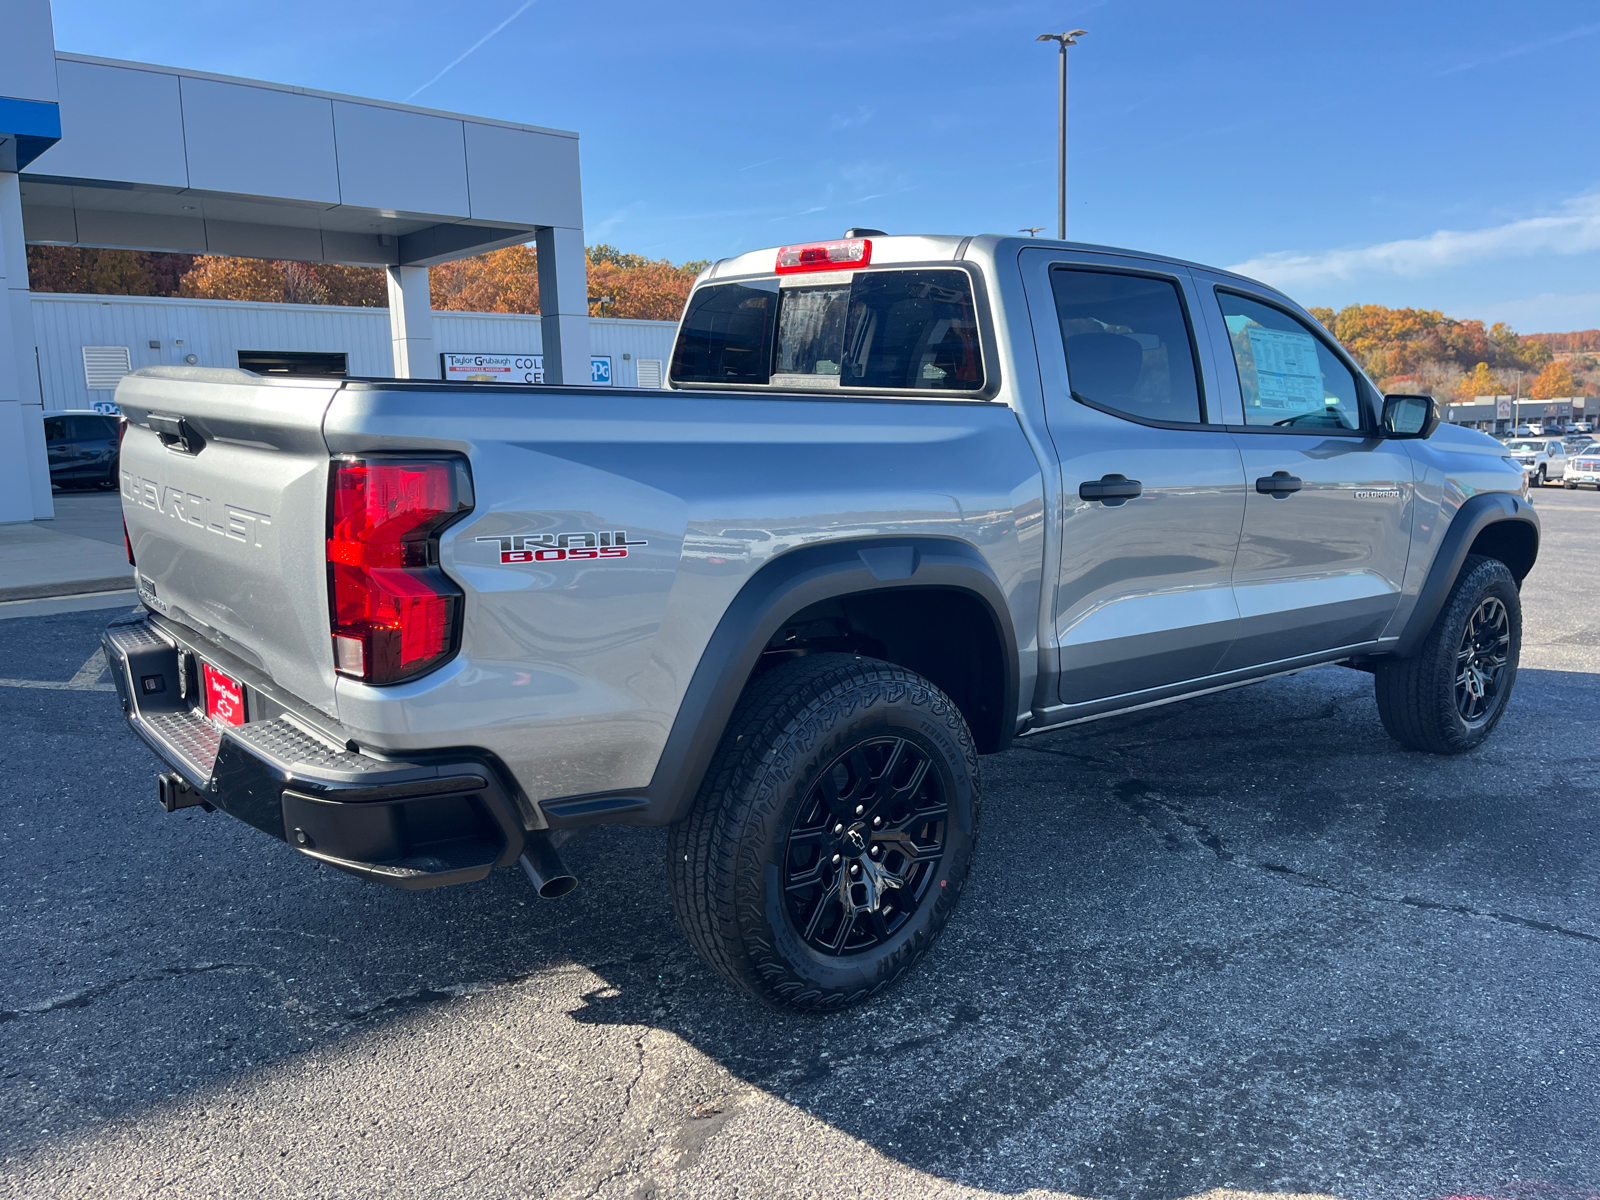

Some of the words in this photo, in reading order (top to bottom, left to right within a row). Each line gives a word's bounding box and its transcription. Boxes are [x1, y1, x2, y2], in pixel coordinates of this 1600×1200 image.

[448, 355, 473, 366] Taylor
[474, 356, 511, 366] Grubaugh
[524, 372, 544, 383] CE
[591, 362, 609, 381] PG
[1354, 491, 1399, 499] COLORADO
[121, 469, 271, 548] CHEVROLET
[475, 531, 648, 551] TRAIL
[500, 546, 628, 564] BOSS
[919, 720, 960, 768] TERRITORY
